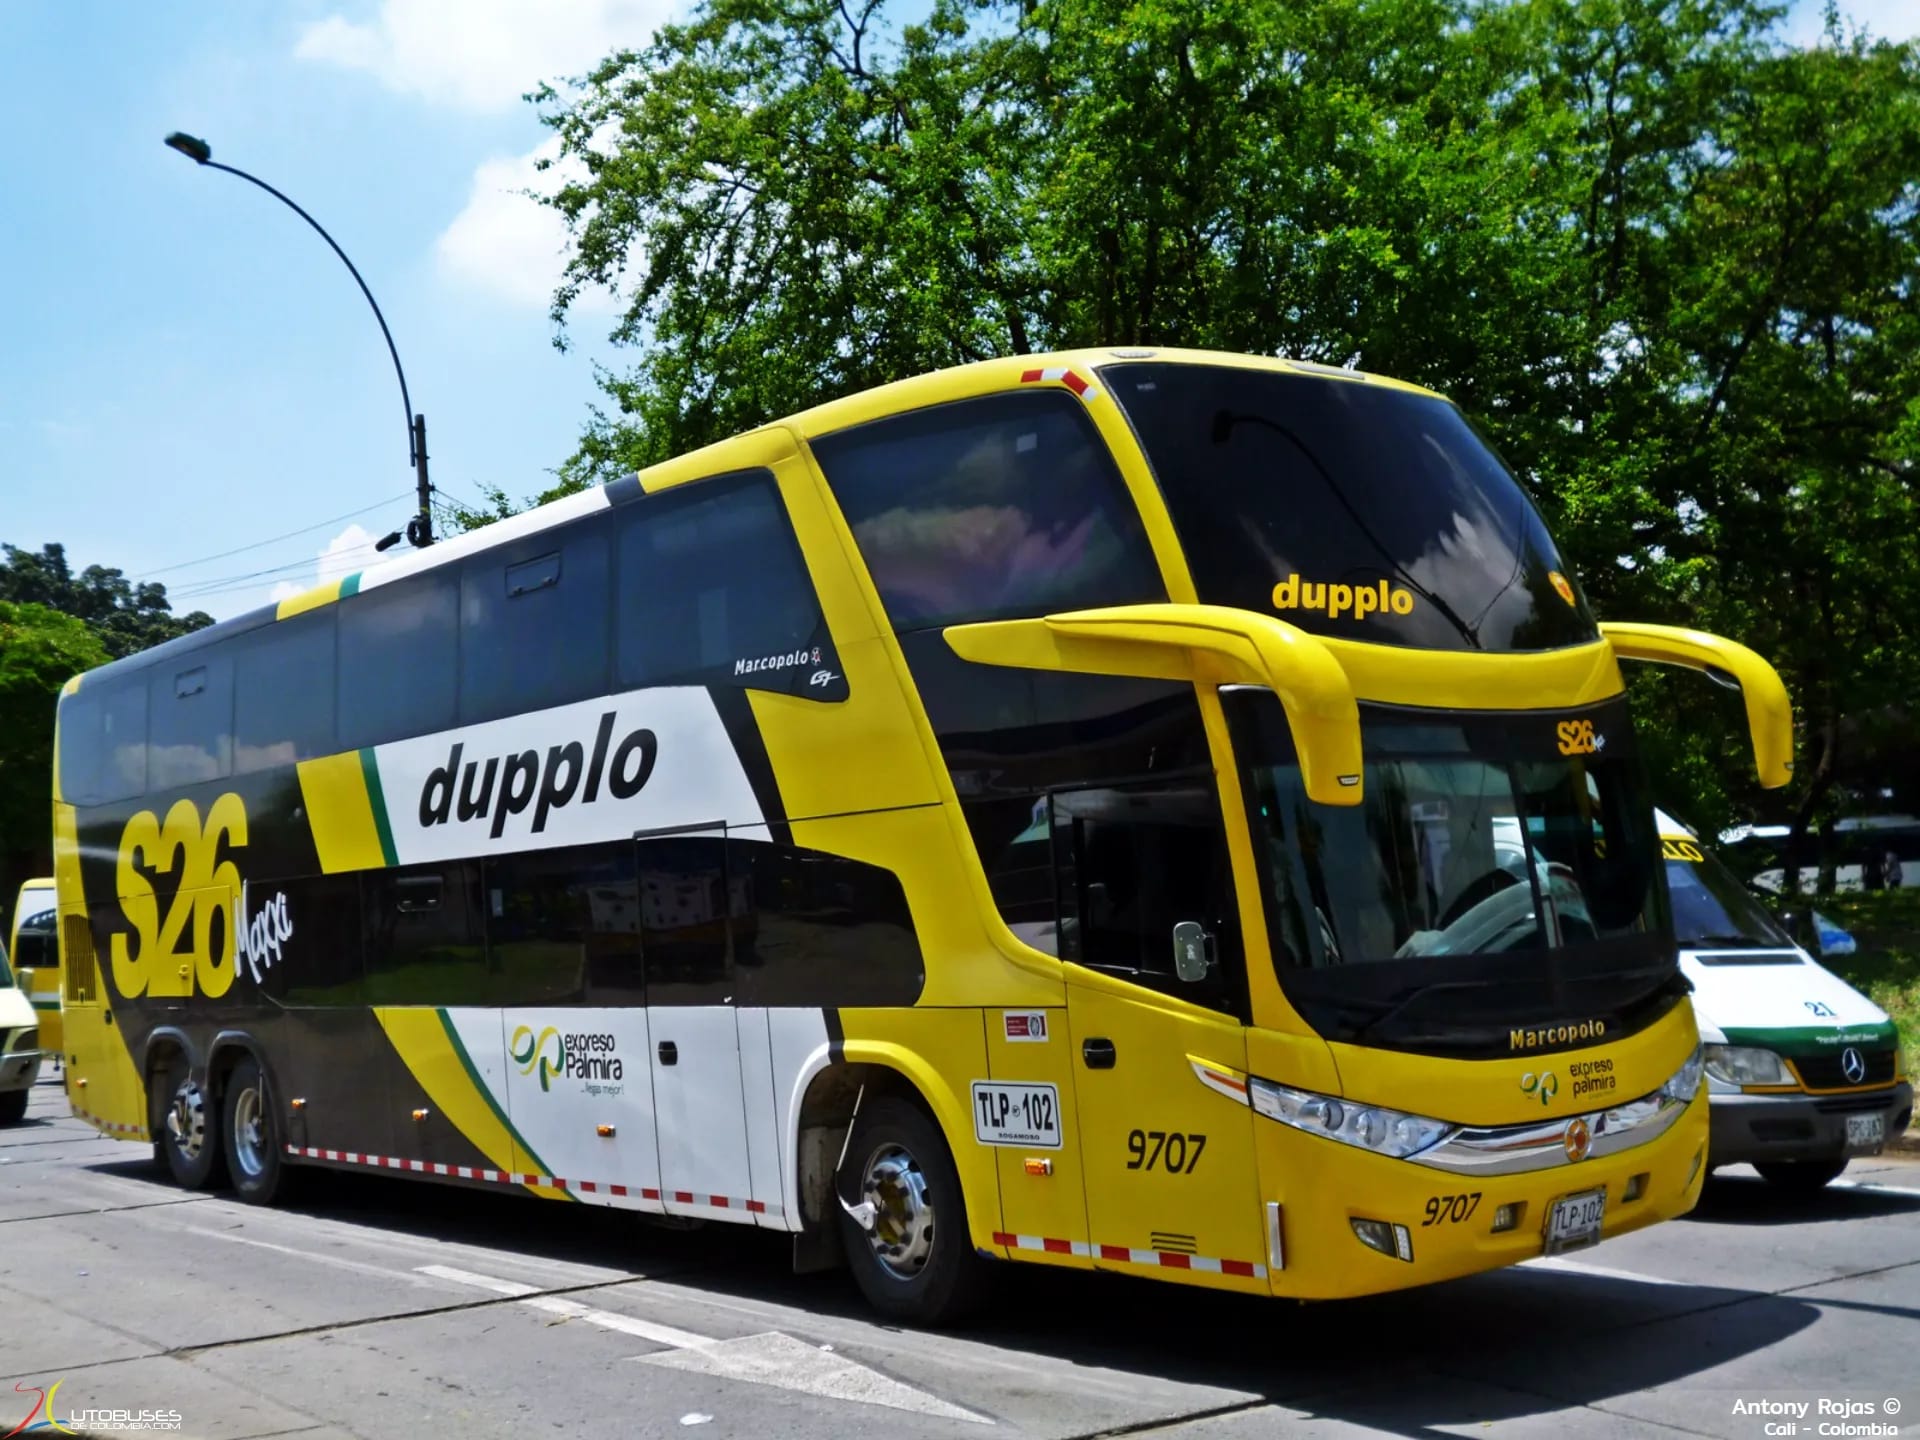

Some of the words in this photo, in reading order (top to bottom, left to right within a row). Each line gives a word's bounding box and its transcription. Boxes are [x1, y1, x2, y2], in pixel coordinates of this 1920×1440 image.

[1272, 573, 1414, 620] dupplo
[734, 649, 809, 676] Marcopolo
[1557, 719, 1595, 756] S26
[419, 710, 657, 839] dupplo
[110, 792, 249, 999] S26
[234, 878, 294, 984] Maxxi
[1804, 1001, 1837, 1016] 21
[564, 1033, 615, 1056] expreso
[1509, 1019, 1605, 1050] Marcopolo
[565, 1052, 623, 1080] Palmira
[1569, 1058, 1613, 1078] expreso
[1572, 1075, 1616, 1098] palmira
[977, 1091, 1009, 1129] TLP
[1022, 1092, 1054, 1131] 102
[1126, 1128, 1207, 1175] 9707
[1421, 1191, 1482, 1227] 9707
